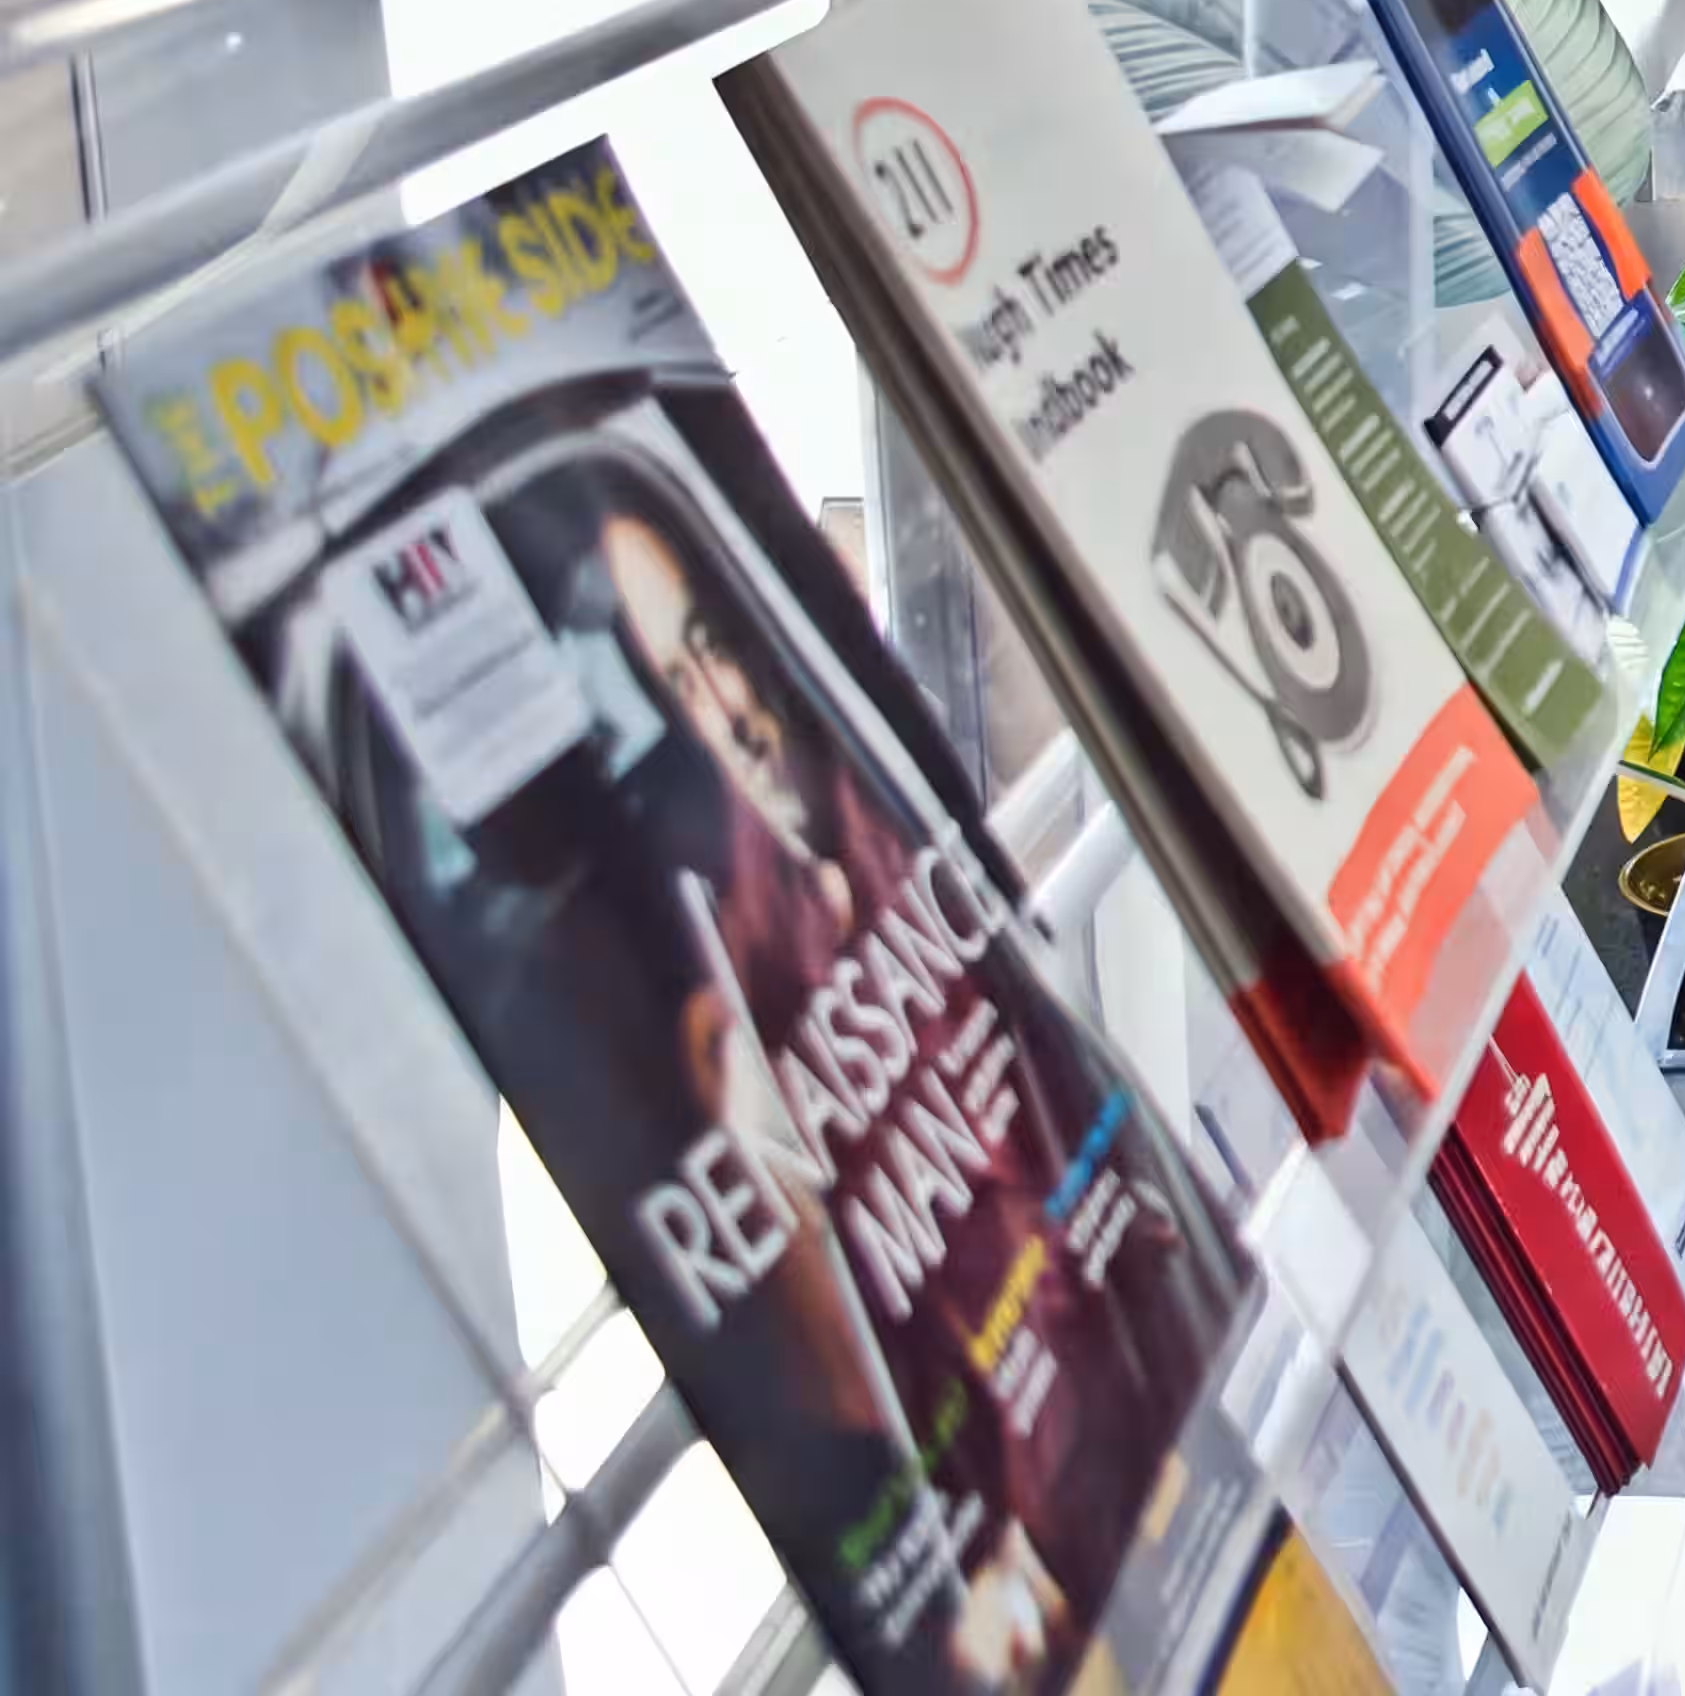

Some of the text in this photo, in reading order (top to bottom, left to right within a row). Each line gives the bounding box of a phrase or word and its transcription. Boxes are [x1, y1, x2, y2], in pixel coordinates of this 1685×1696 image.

[874, 138, 954, 240] 211
[1017, 224, 1120, 318] Times
[846, 1066, 992, 1322] MAN
